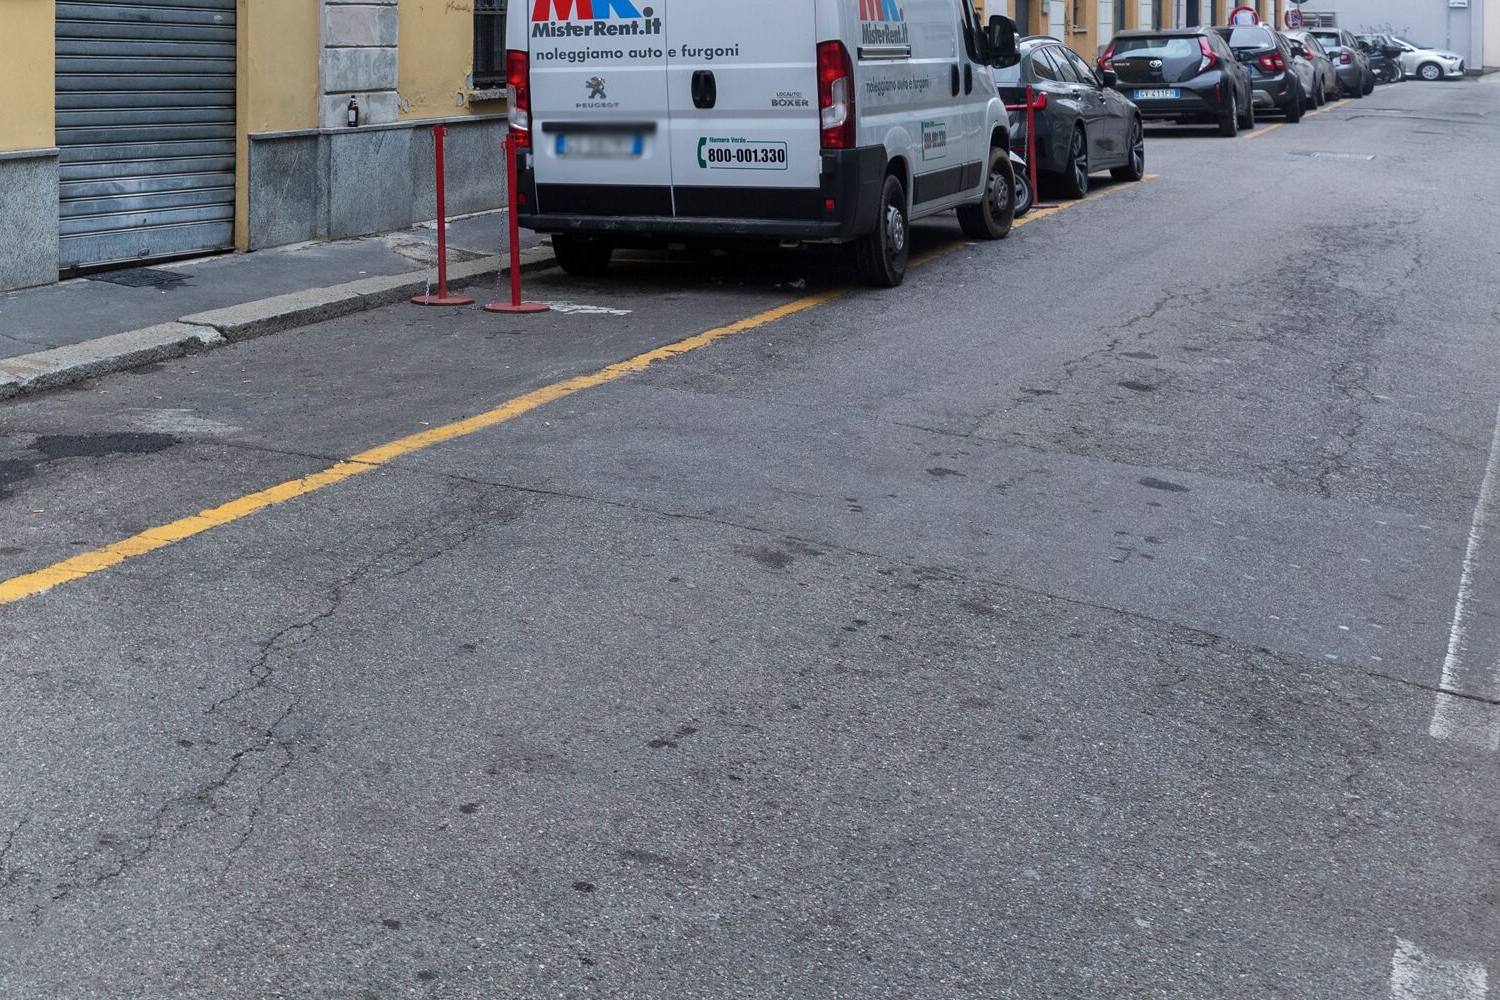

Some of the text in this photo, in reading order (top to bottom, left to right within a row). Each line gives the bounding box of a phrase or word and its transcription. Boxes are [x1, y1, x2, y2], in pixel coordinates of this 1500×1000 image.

[536, 43, 739, 63] noleggiamo auto e furgoni
[866, 76, 896, 96] noleggiamo
[897, 77, 908, 90] auto
[913, 73, 929, 93] furgoni
[771, 99, 809, 107] BOXER
[708, 148, 785, 163] 800-001.330
